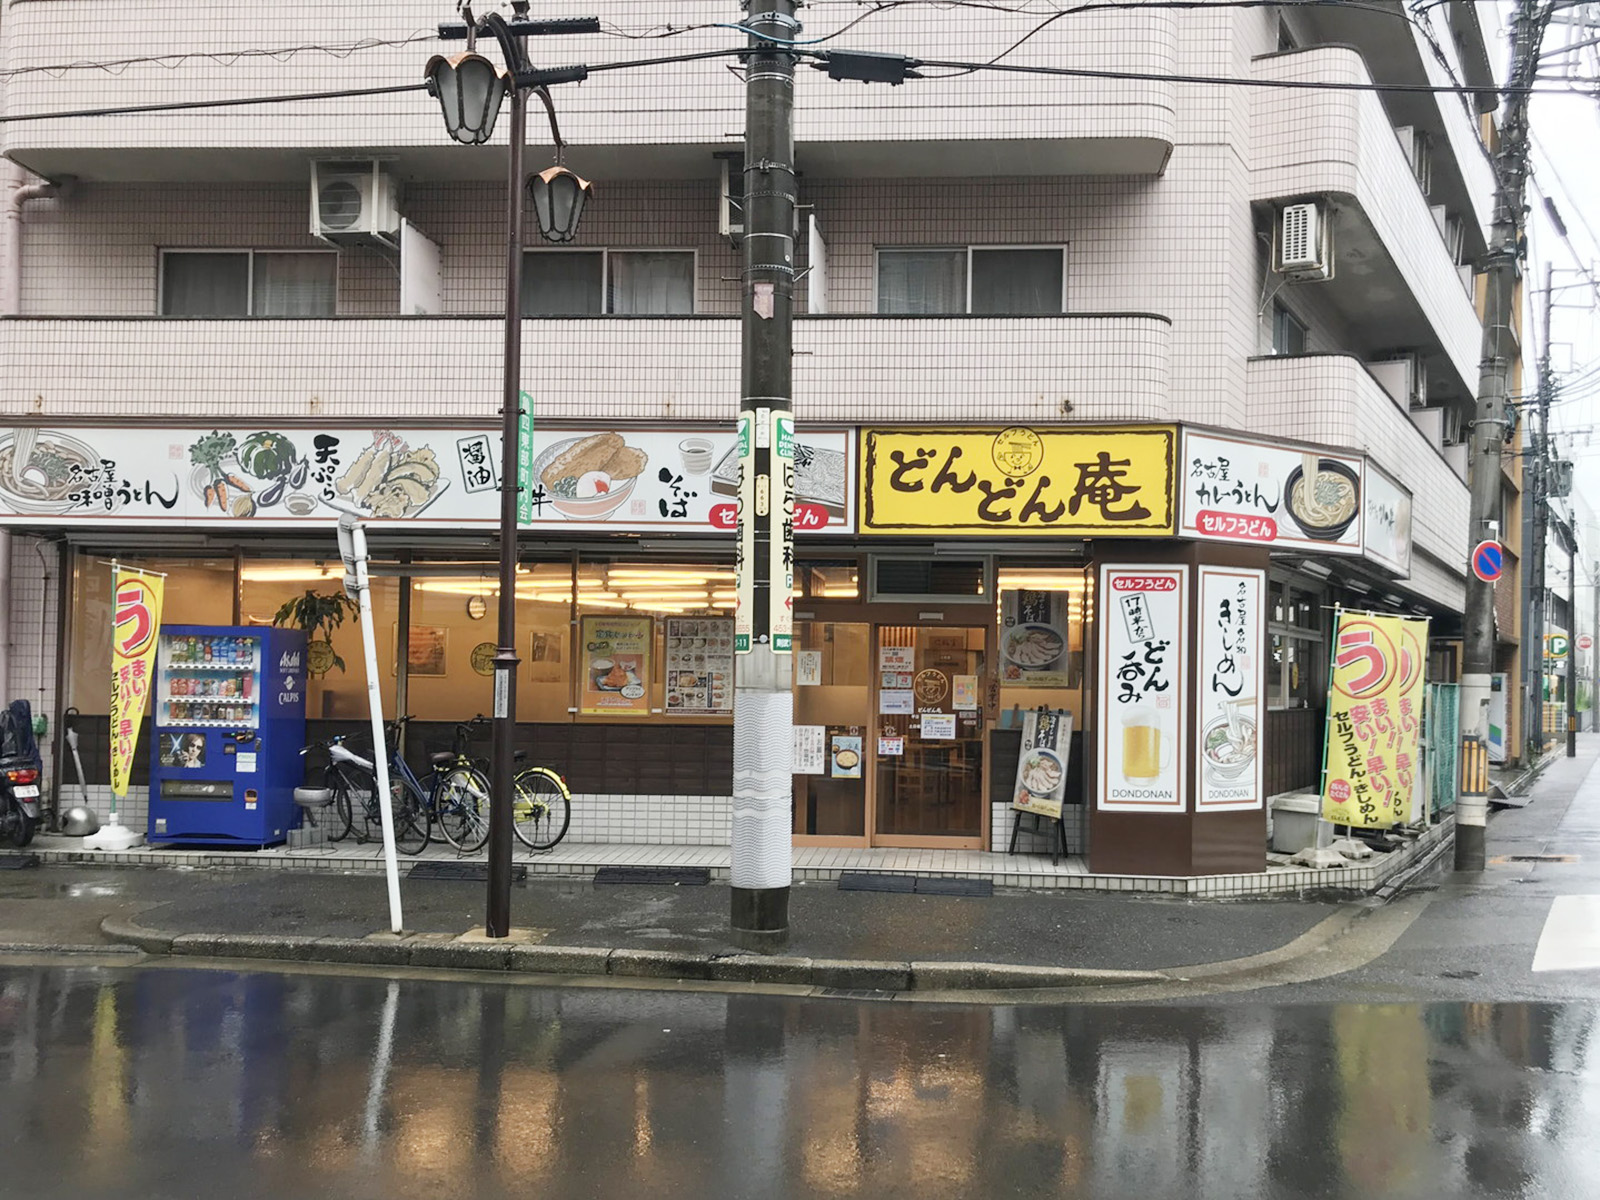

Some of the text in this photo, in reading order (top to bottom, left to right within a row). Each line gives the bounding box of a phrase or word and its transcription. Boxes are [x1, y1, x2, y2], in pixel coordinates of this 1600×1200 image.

[997, 428, 1039, 447] セルフうどん
[68, 459, 118, 484] 名古屋
[311, 433, 340, 501] 天ぷら
[462, 441, 491, 487] 醤油
[890, 446, 1152, 523] どんどん庵
[1190, 457, 1230, 481] 名古屋
[68, 474, 179, 511] 味噌うどん
[658, 467, 697, 518] そば
[1195, 477, 1281, 513] カレーうどん
[1202, 514, 1272, 538] セルフうどん
[1114, 578, 1176, 591] セルフうどん
[115, 589, 150, 655] う
[1236, 581, 1248, 655] 名古屋名物
[1143, 639, 1171, 692] どん
[1212, 598, 1244, 697] きしめん
[1554, 638, 1567, 653] P
[278, 692, 299, 705] CALPIS
[1116, 651, 1146, 703] 呑み
[1336, 630, 1396, 749] う まい!
[1333, 710, 1378, 825] セルフうどん・きしめん
[1350, 705, 1393, 808] 安い! 早い!
[1112, 788, 1173, 799] DONDONAN
[1208, 788, 1249, 799] DONDONAN
